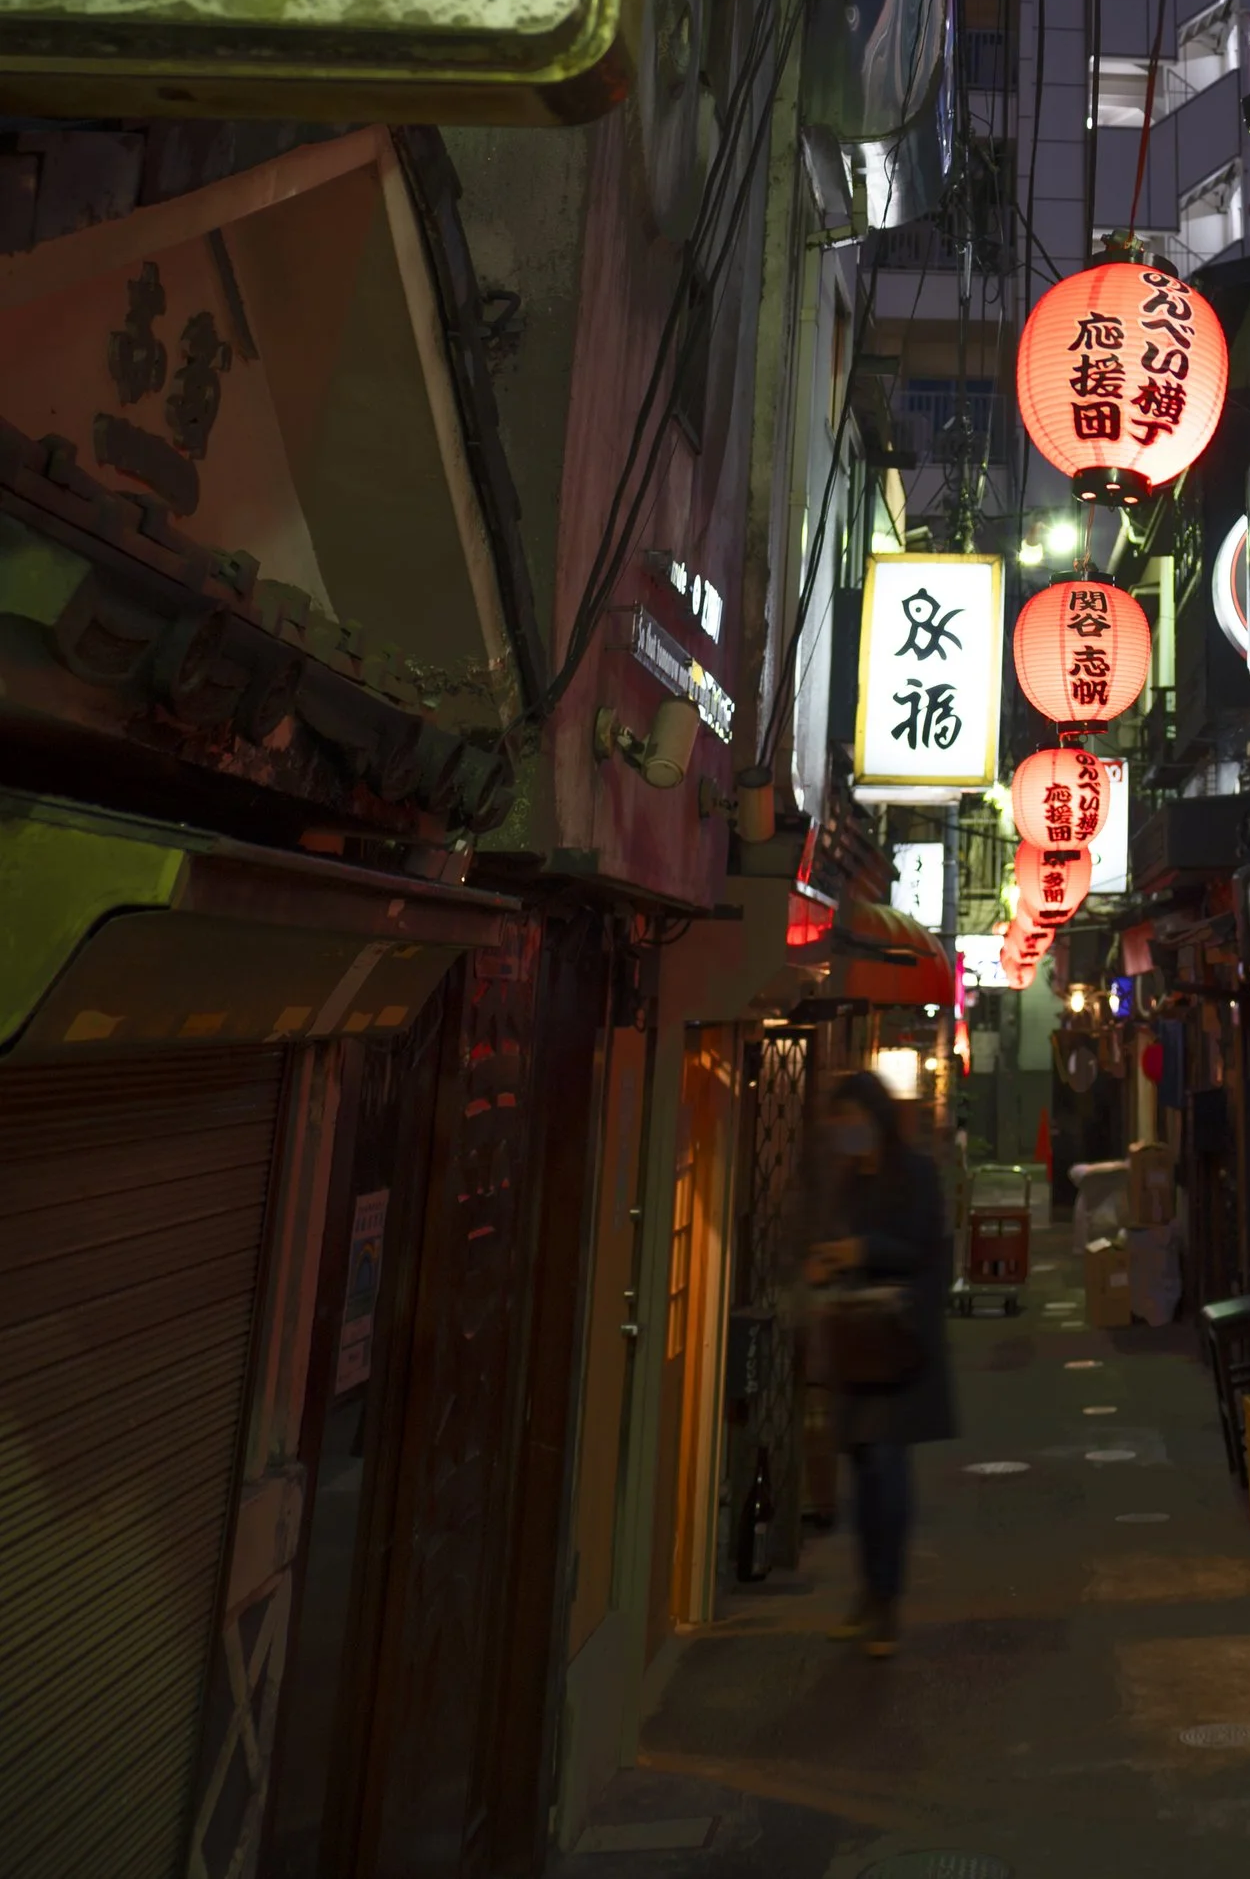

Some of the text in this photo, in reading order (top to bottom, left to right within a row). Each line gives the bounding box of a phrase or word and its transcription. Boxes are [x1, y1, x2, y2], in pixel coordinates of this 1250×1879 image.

[1067, 311, 1126, 442] 応援団
[1130, 272, 1195, 446] のんべい横丁
